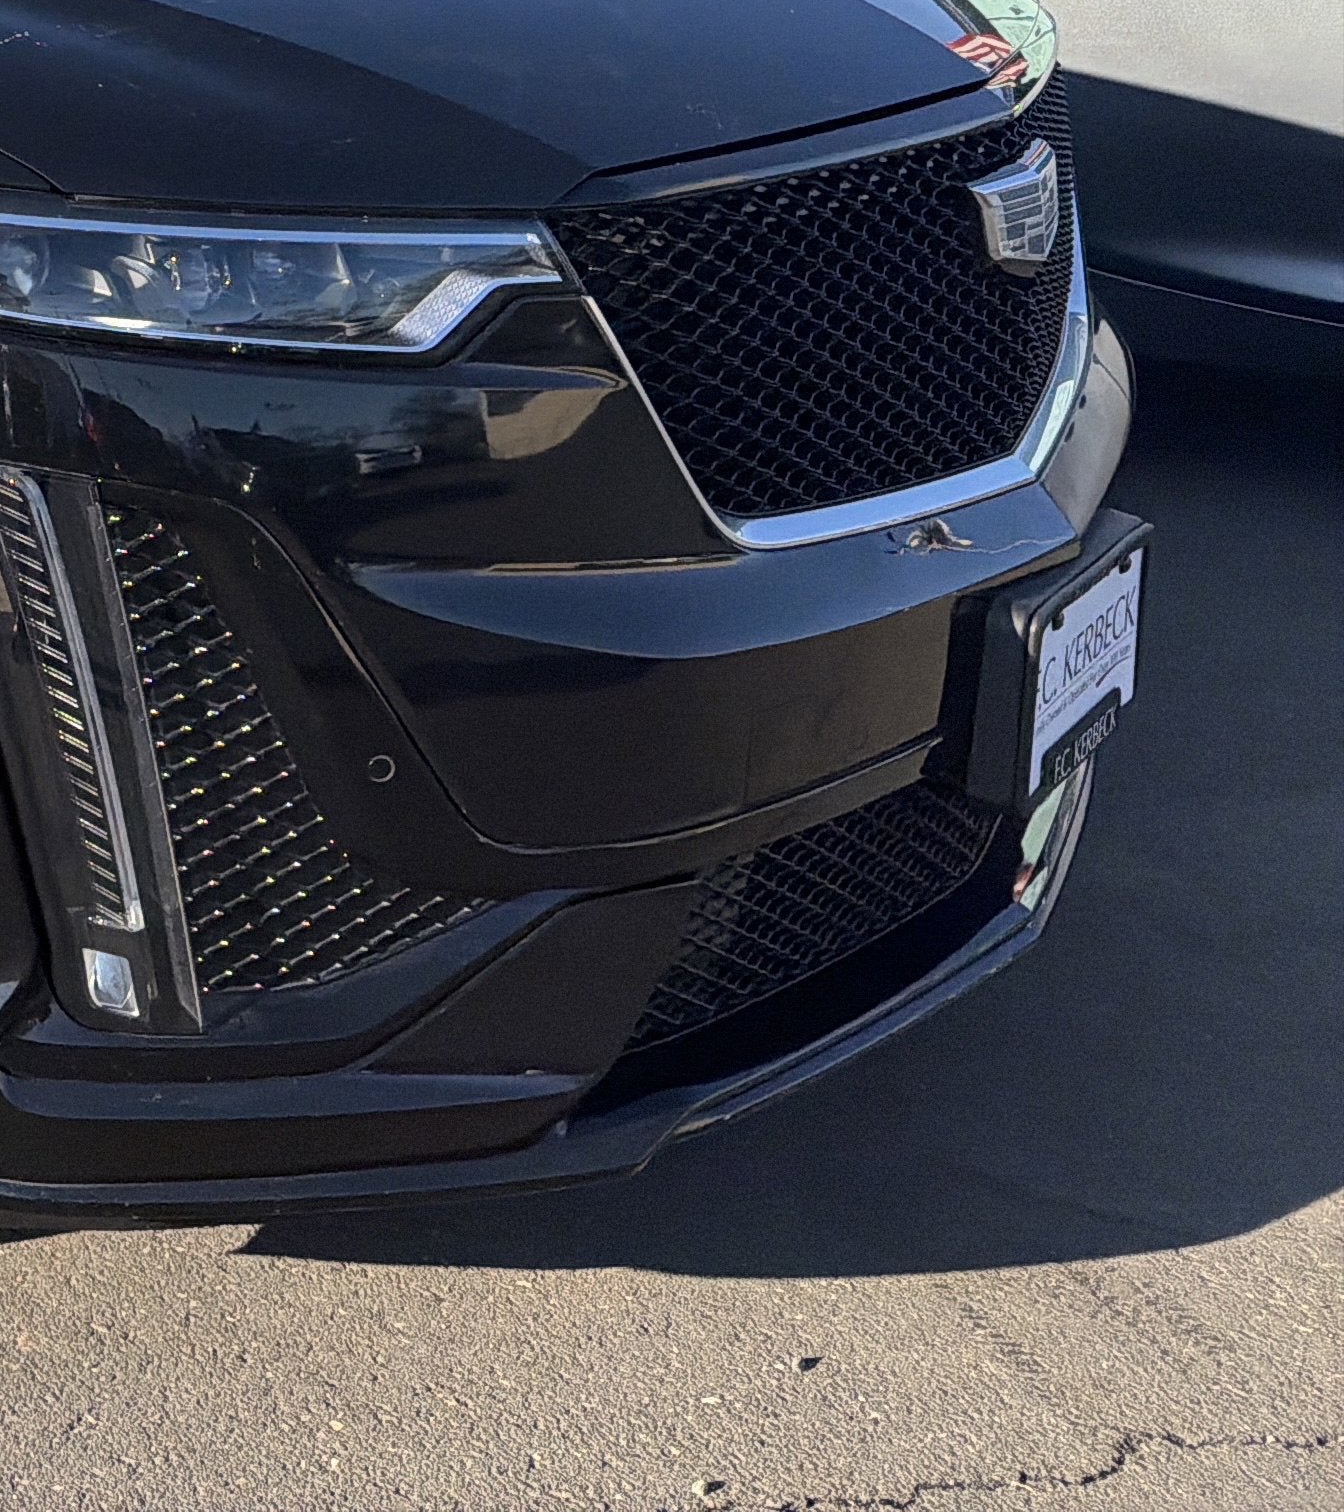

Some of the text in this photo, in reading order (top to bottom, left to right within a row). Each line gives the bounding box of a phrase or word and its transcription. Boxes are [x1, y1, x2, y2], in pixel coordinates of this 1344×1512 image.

[1038, 656, 1058, 711] .C.
[1063, 585, 1137, 688] KERBECK
[1073, 703, 1118, 765] KERBECK
